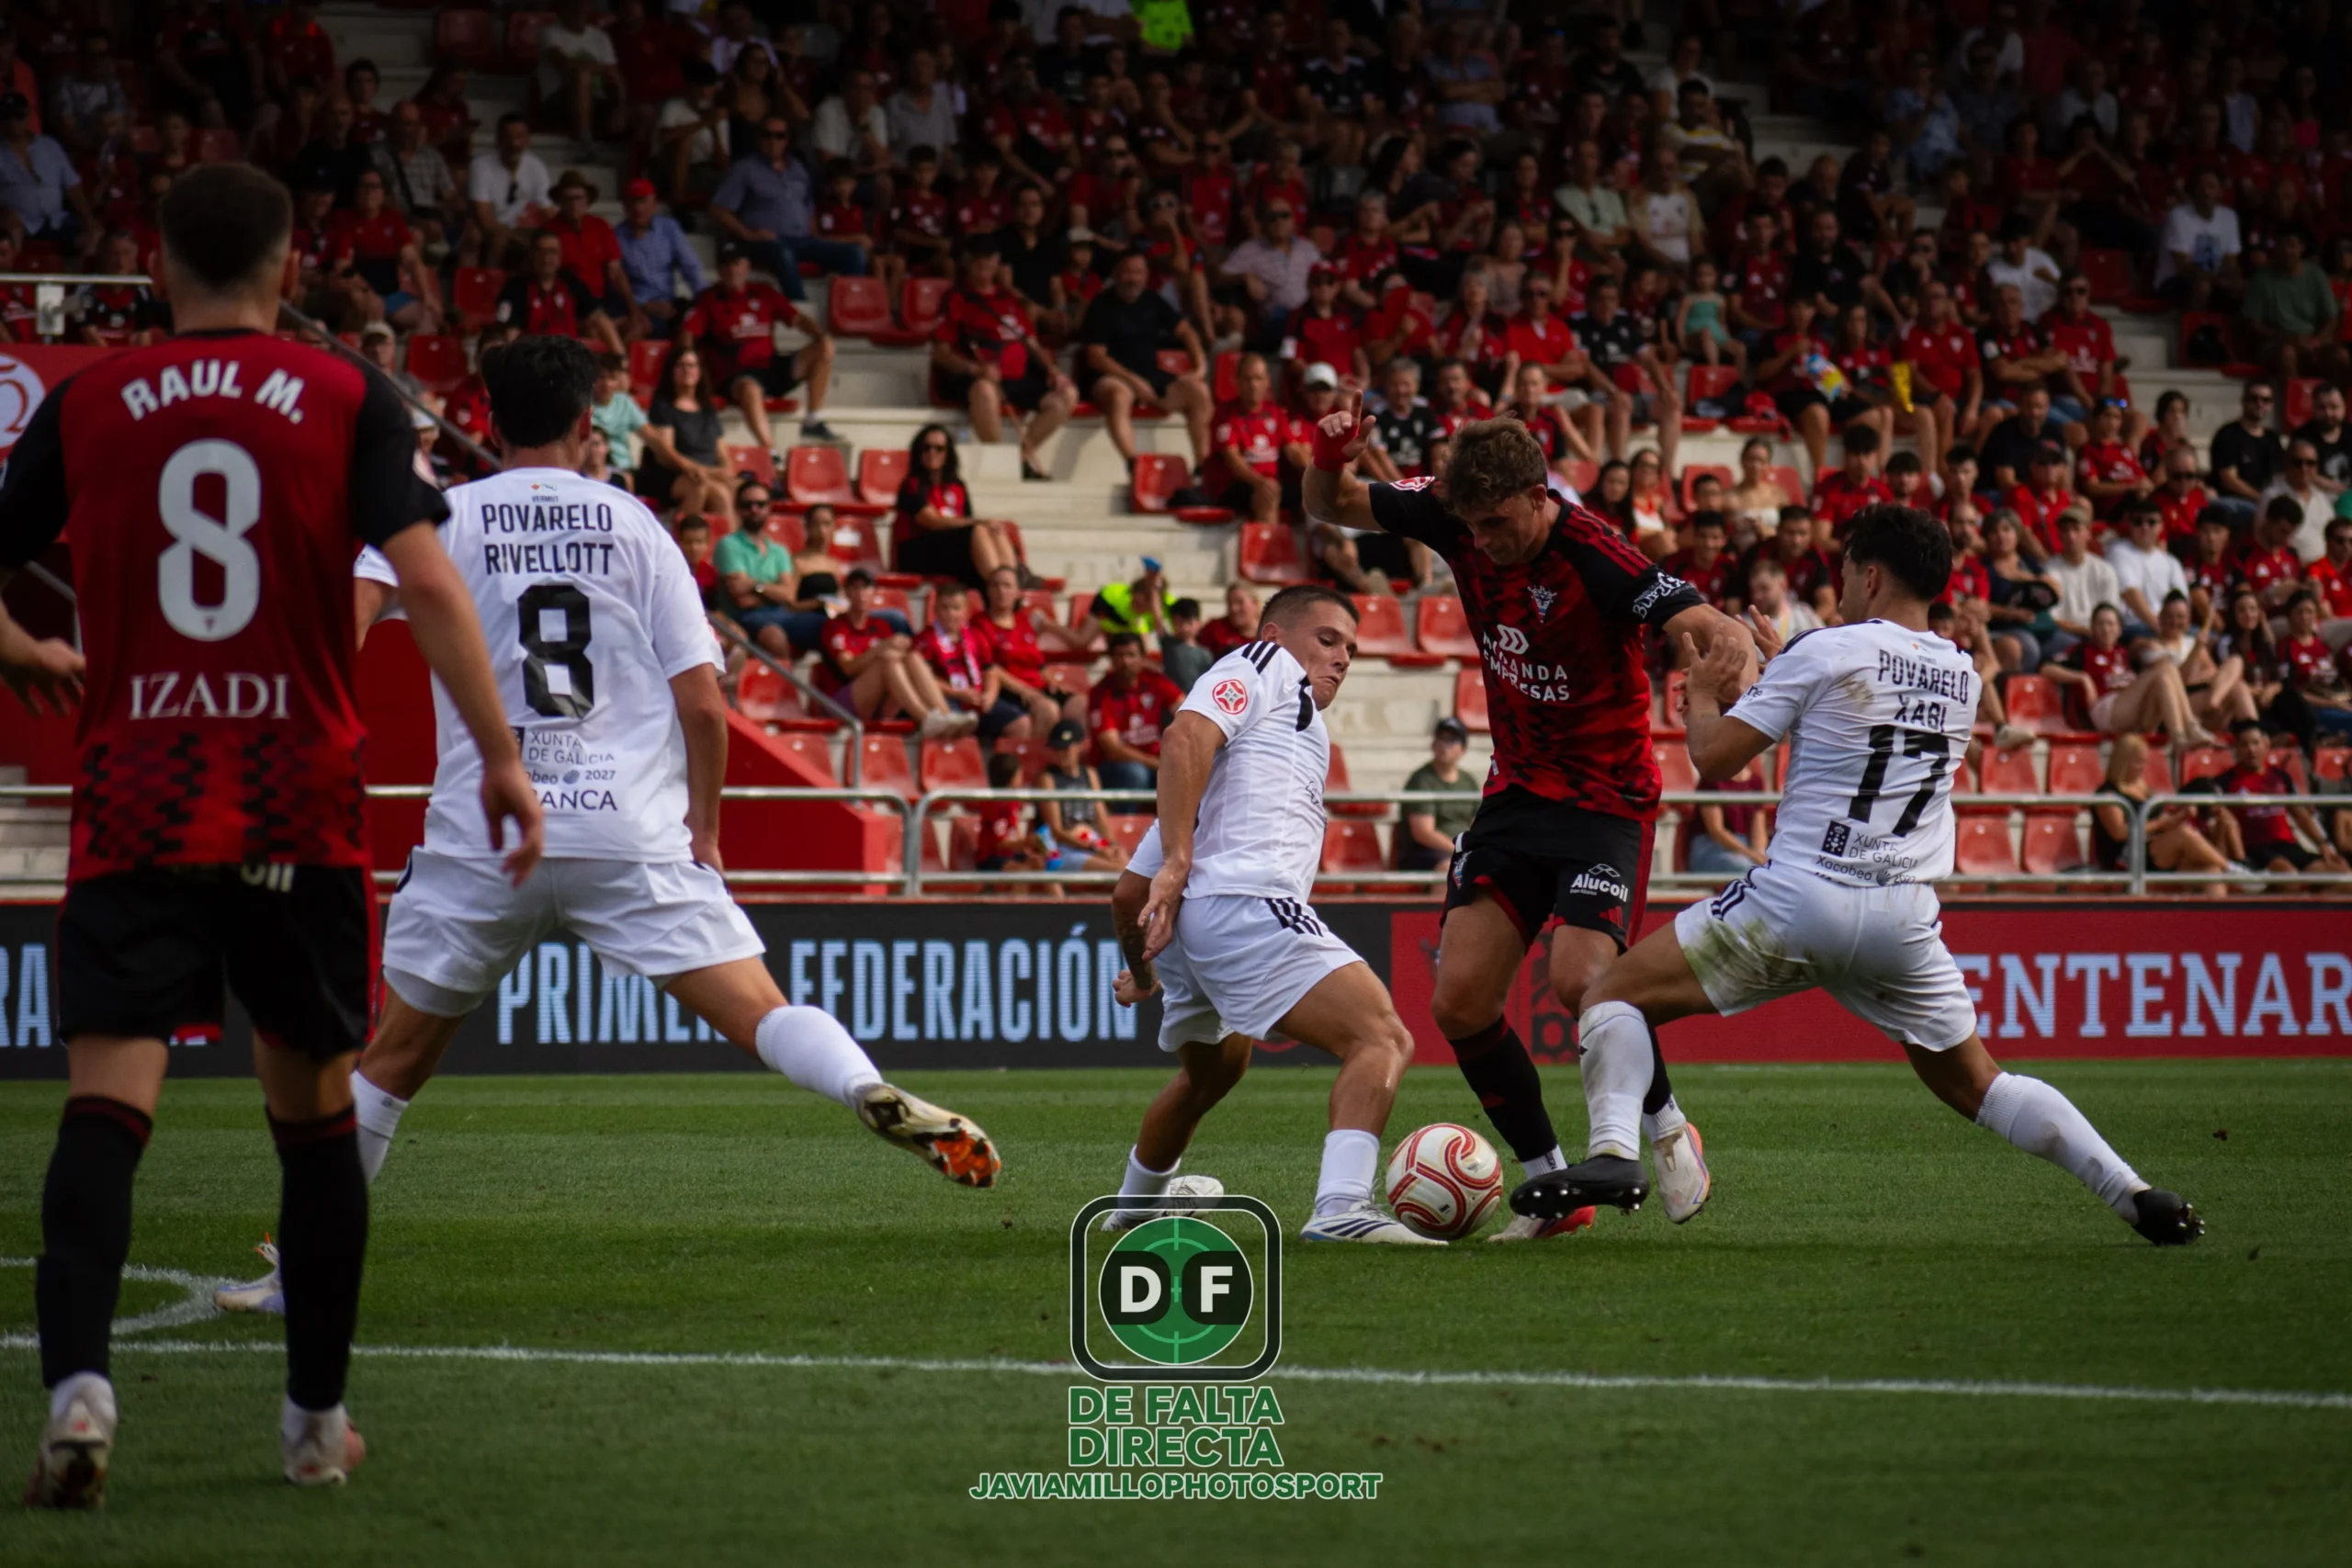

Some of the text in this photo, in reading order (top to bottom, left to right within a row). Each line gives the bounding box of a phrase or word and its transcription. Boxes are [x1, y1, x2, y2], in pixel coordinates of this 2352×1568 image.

[120, 359, 304, 424] RAUL M.
[481, 503, 613, 535] POVARELO
[158, 438, 261, 641] 8
[484, 542, 613, 575] RIVELLOTT
[517, 584, 594, 720] 8
[1878, 649, 1969, 705] POVARELO
[129, 671, 291, 720] IZADI
[1894, 694, 1947, 733] XABI
[528, 748, 615, 765] DE GALICIA
[531, 731, 583, 750] XUNTA
[585, 770, 616, 781] 2027
[1848, 724, 1951, 838] 17
[531, 789, 617, 811] ANCA
[1849, 847, 1867, 860] DE
[1854, 833, 1898, 852] XUNTA
[1815, 854, 1872, 881] Xacobeo
[1571, 873, 1629, 903] Alucoil
[791, 922, 1137, 1042] FEDERACIÓN
